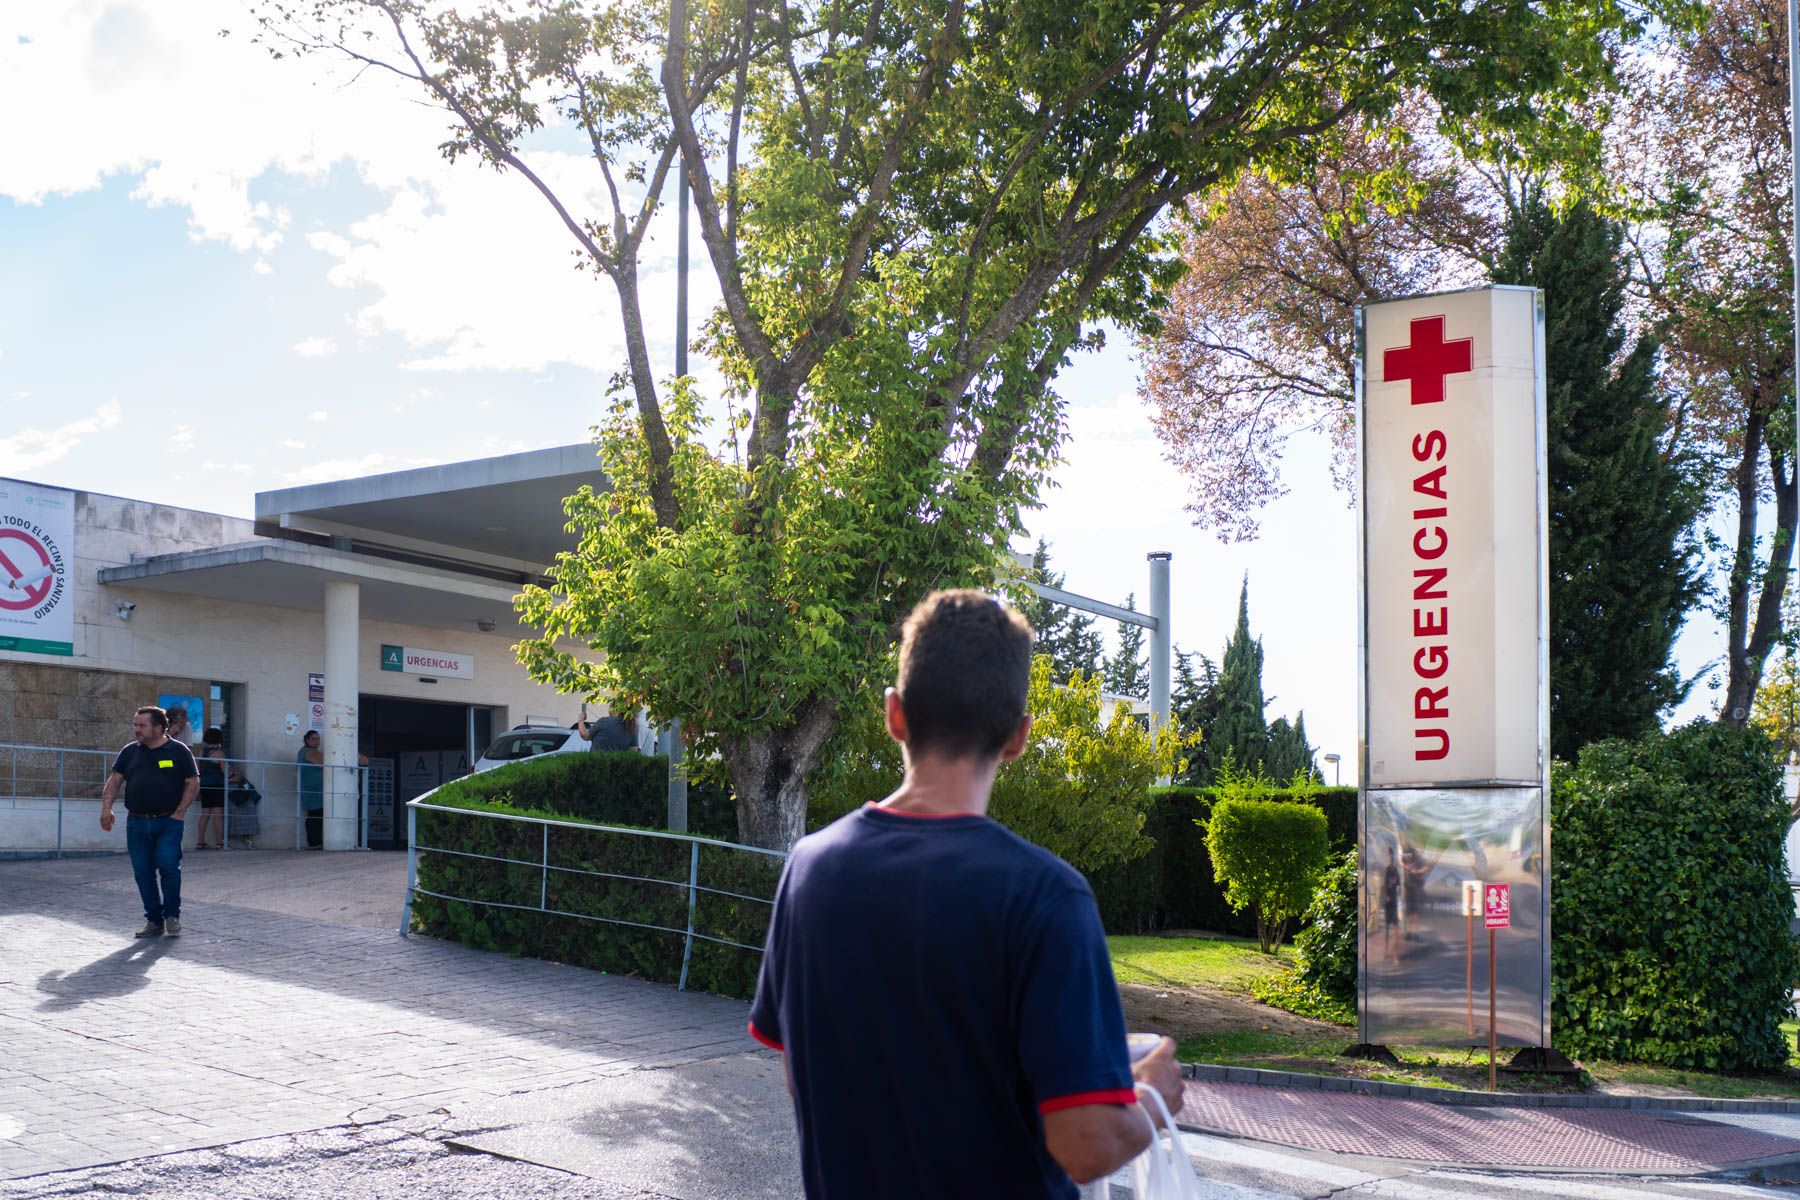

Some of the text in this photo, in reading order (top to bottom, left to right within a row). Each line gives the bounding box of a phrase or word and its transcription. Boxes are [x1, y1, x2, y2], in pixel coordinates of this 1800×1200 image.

[4, 516, 31, 530] TODO
[32, 525, 42, 537] EL
[42, 535, 65, 575] RECINTO
[34, 577, 65, 619] SANITARIO
[1412, 430, 1450, 761] URGENCIAS
[407, 656, 459, 671] URGENCIAS
